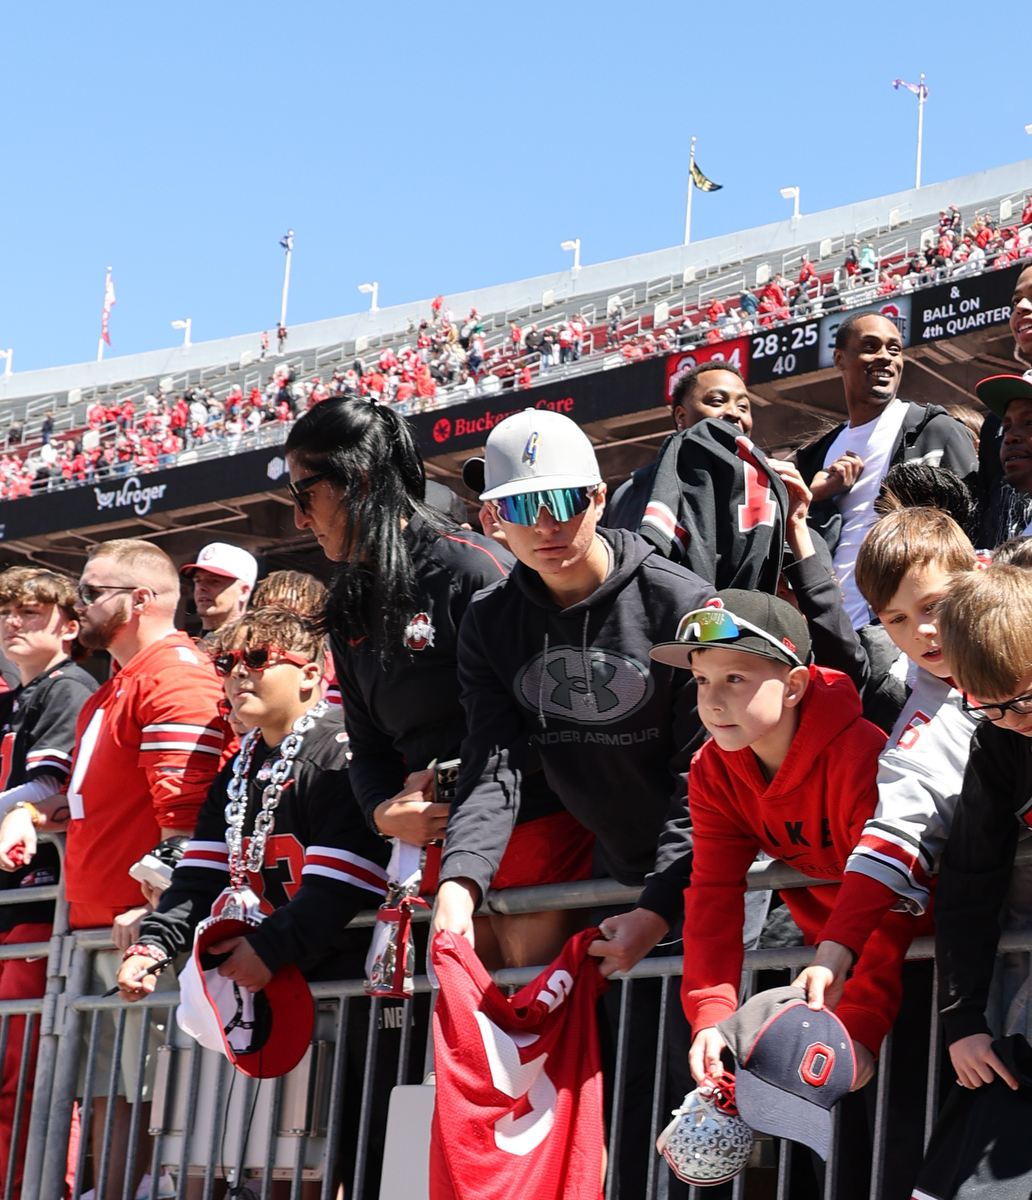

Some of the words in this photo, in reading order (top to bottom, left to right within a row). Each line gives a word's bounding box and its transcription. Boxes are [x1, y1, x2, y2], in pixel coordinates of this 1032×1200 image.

[949, 285, 961, 299] &
[922, 324, 944, 339] 4th
[946, 306, 1012, 335] QUARTER
[923, 303, 957, 323] BALL
[959, 297, 980, 313] ON
[752, 323, 819, 359] 28:25
[772, 353, 797, 375] 40
[454, 408, 522, 437] Buck
[115, 477, 167, 515] Kroger
[530, 730, 582, 746] NDER
[583, 727, 660, 746] ARMOUR
